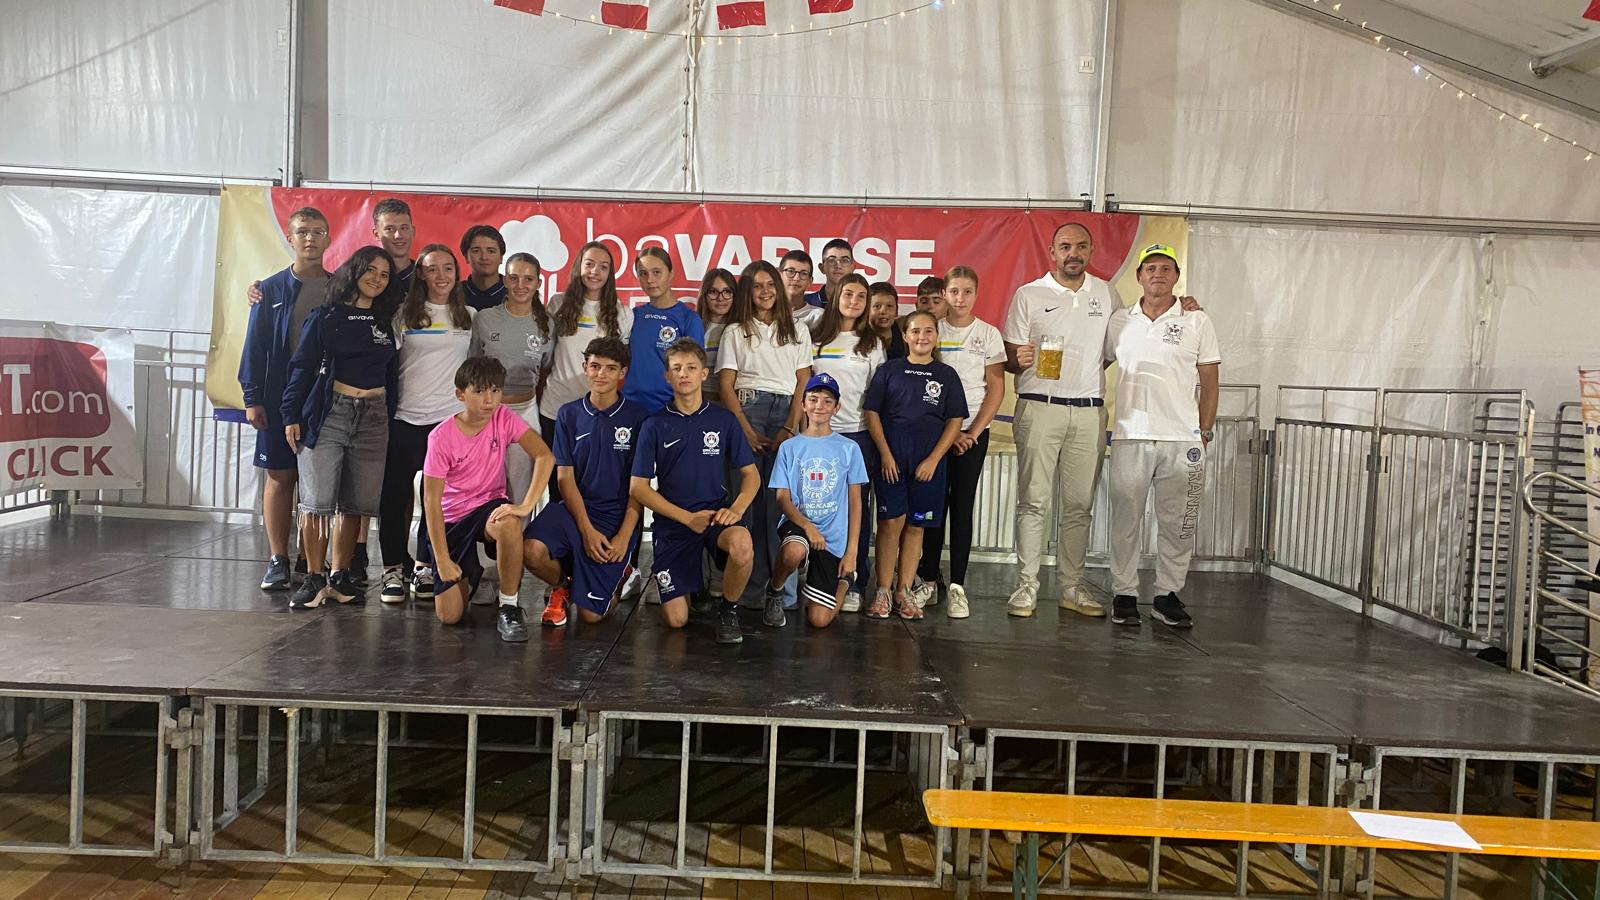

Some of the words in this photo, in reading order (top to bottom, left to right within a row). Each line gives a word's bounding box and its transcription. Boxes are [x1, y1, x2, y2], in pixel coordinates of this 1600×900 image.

[0, 364, 104, 415] T.com
[7, 445, 115, 481] CLICK
[1179, 462, 1203, 540] FRANKLIN
